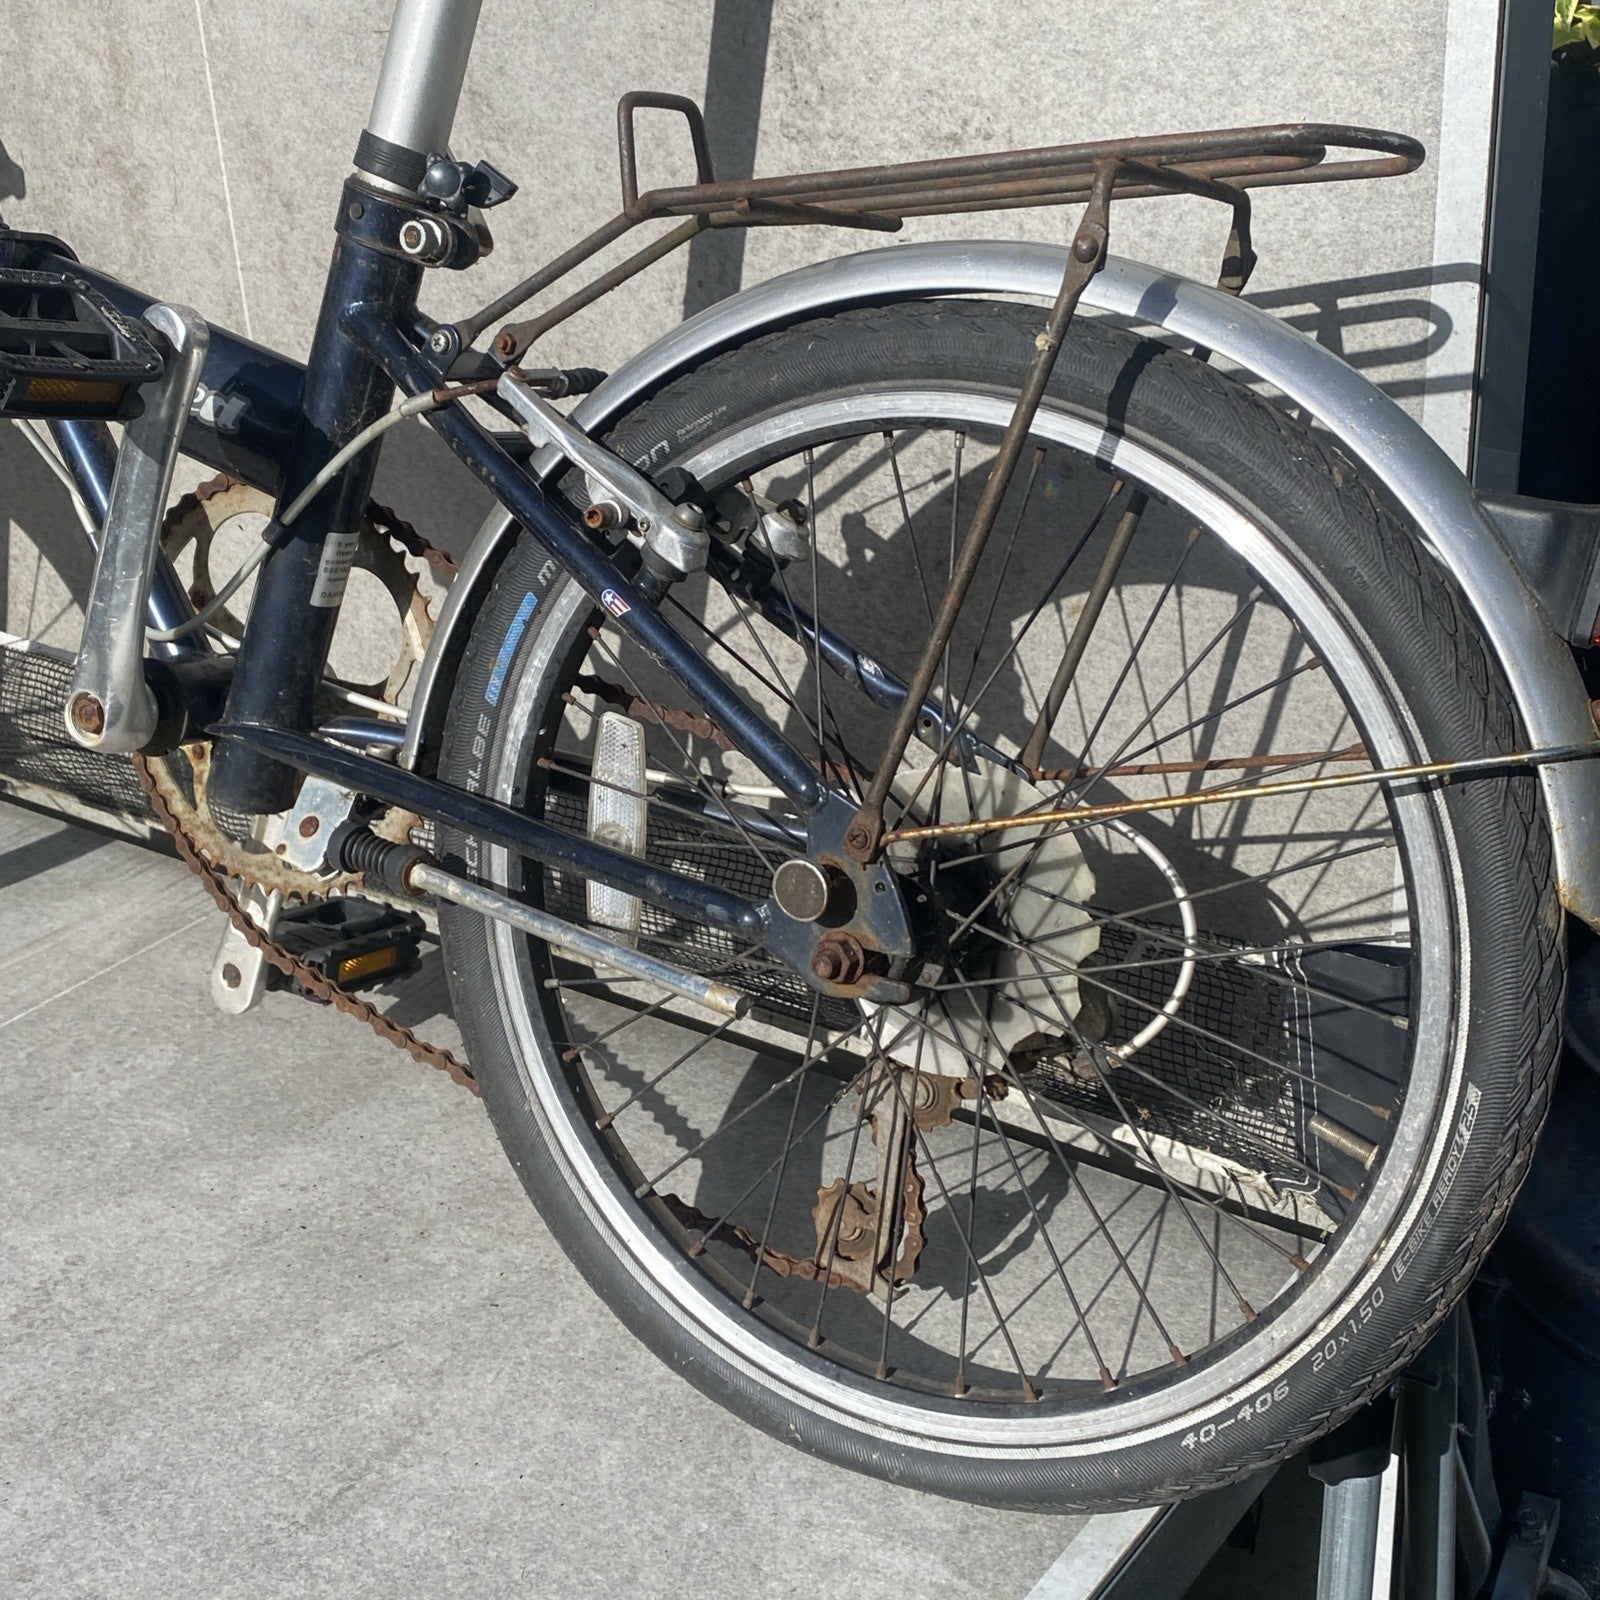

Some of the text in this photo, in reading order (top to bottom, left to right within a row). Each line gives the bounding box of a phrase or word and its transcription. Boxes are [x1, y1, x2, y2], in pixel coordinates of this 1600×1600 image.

[1181, 1378, 1290, 1450] 40-406
[1393, 1211, 1433, 1276] E-BIKE
[1432, 1149, 1462, 1211] READY
